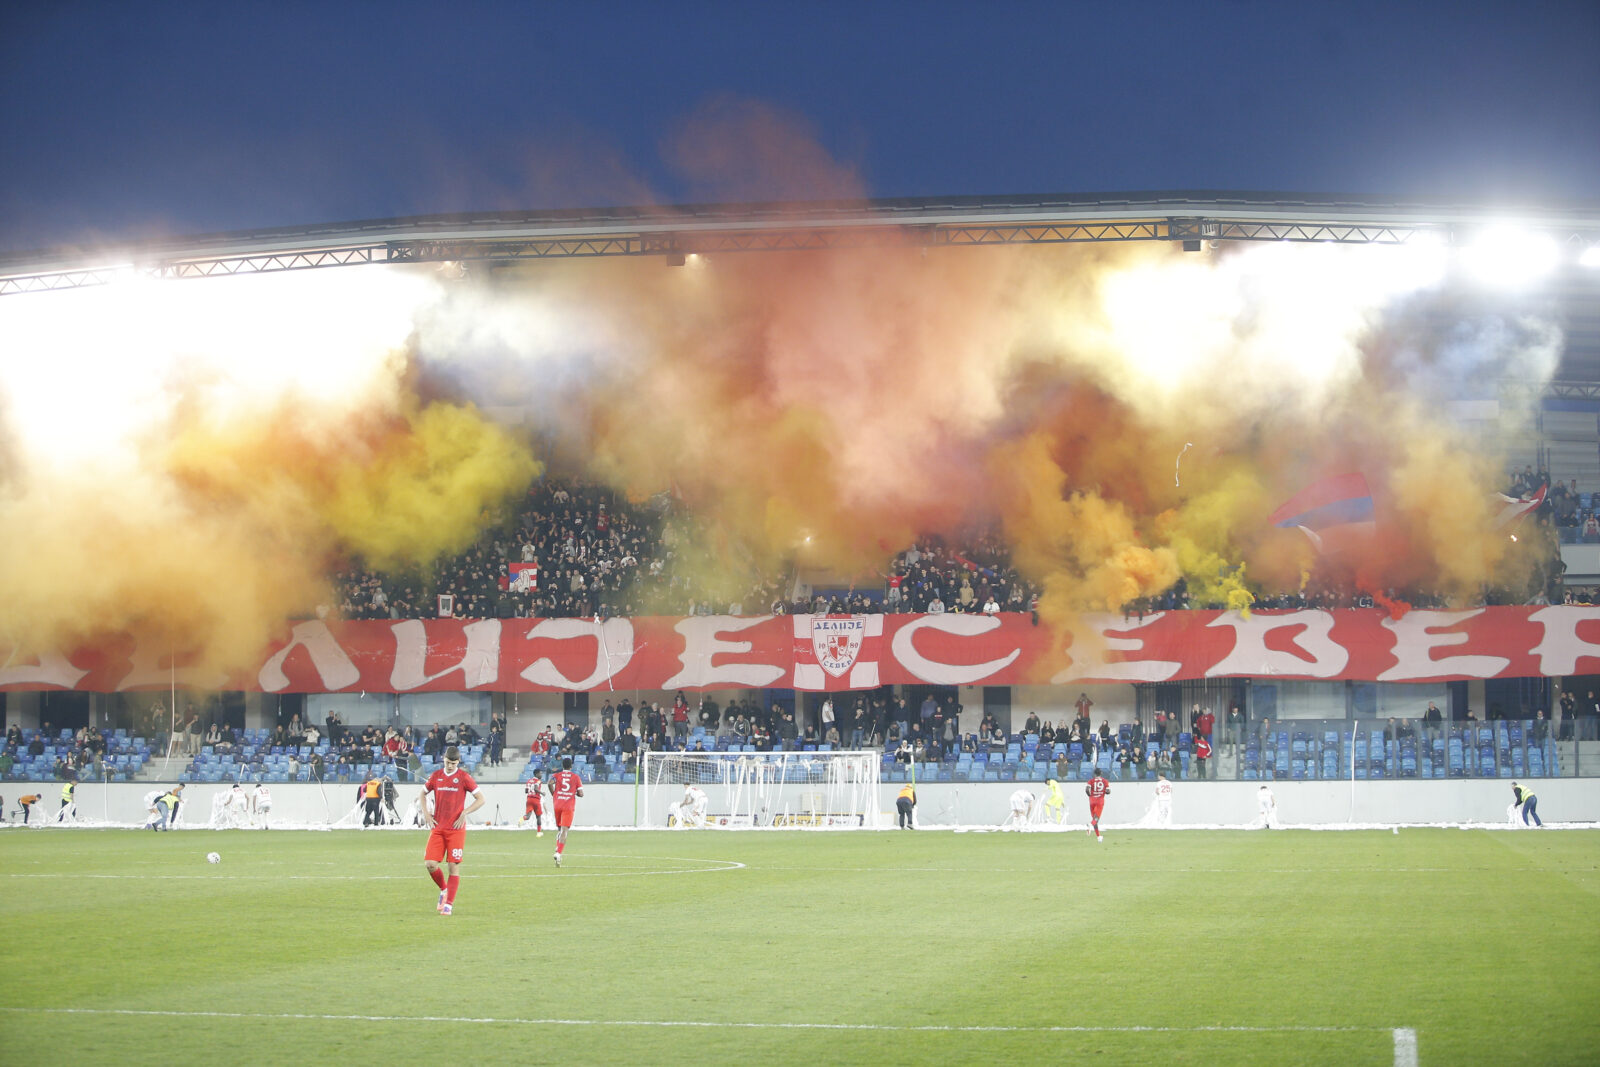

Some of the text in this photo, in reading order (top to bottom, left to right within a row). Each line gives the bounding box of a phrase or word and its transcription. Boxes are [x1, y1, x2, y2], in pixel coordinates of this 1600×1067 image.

[561, 778, 570, 791] 5
[1093, 781, 1104, 791] 19
[1160, 784, 1171, 793] 25
[452, 848, 462, 857] 80
